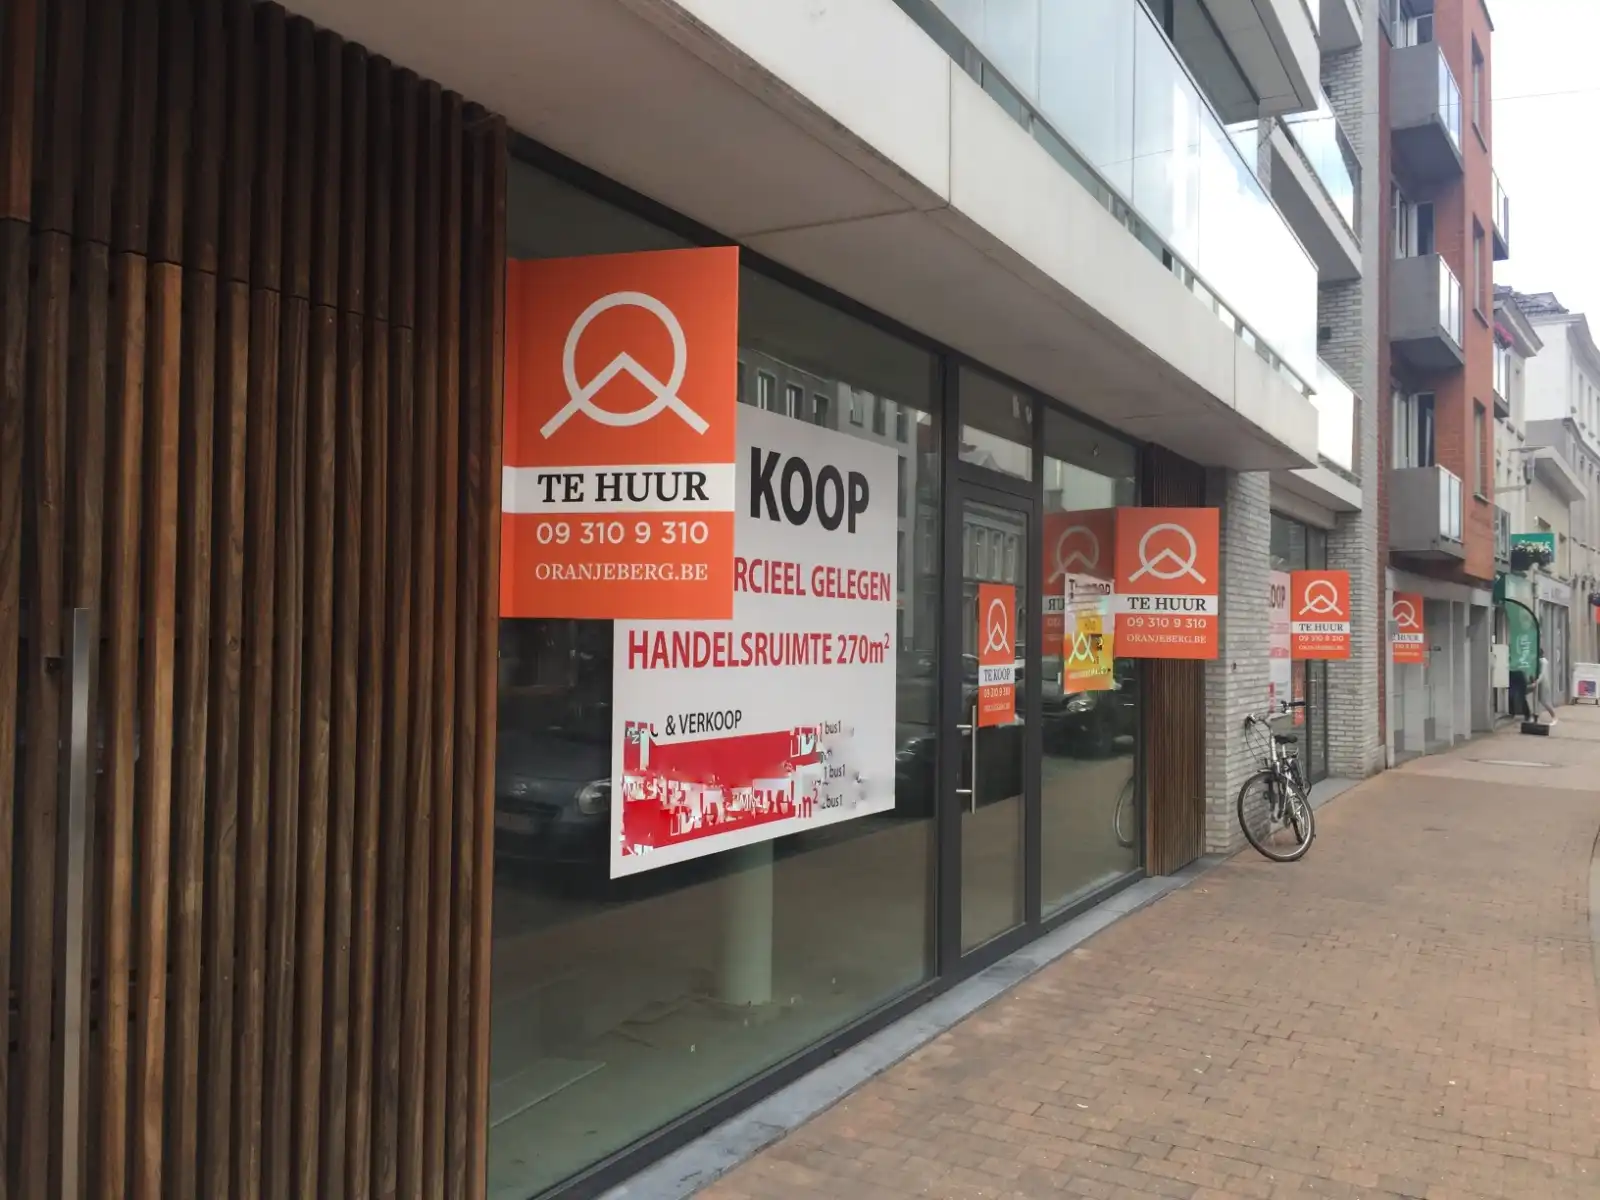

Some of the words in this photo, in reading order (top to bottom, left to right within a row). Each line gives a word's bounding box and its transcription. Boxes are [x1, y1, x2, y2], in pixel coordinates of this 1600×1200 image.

[537, 473, 585, 503] TE
[594, 471, 710, 502] HUUR
[750, 446, 870, 534] KOOP
[536, 521, 571, 545] 09
[580, 521, 625, 545] 310
[634, 521, 651, 544] 9
[661, 520, 709, 544] 310
[535, 562, 708, 581] ORANJEBERG.BE
[811, 565, 891, 602] GELEGEN
[1127, 597, 1150, 610] TE
[1155, 597, 1207, 611] HUUR
[1268, 584, 1286, 609] OOP
[1126, 617, 1144, 628] 09
[1148, 617, 1170, 628] 310
[1173, 618, 1181, 628] 9
[1185, 618, 1207, 629] 310
[1299, 623, 1312, 632] TE
[1314, 623, 1344, 632] HUUR
[628, 630, 832, 669] HANDELSRUIMTE
[1126, 633, 1207, 644] ORANJEBERG.BE
[993, 667, 1010, 681] KOOP
[665, 714, 676, 736] &
[679, 709, 742, 734] VERKOOP
